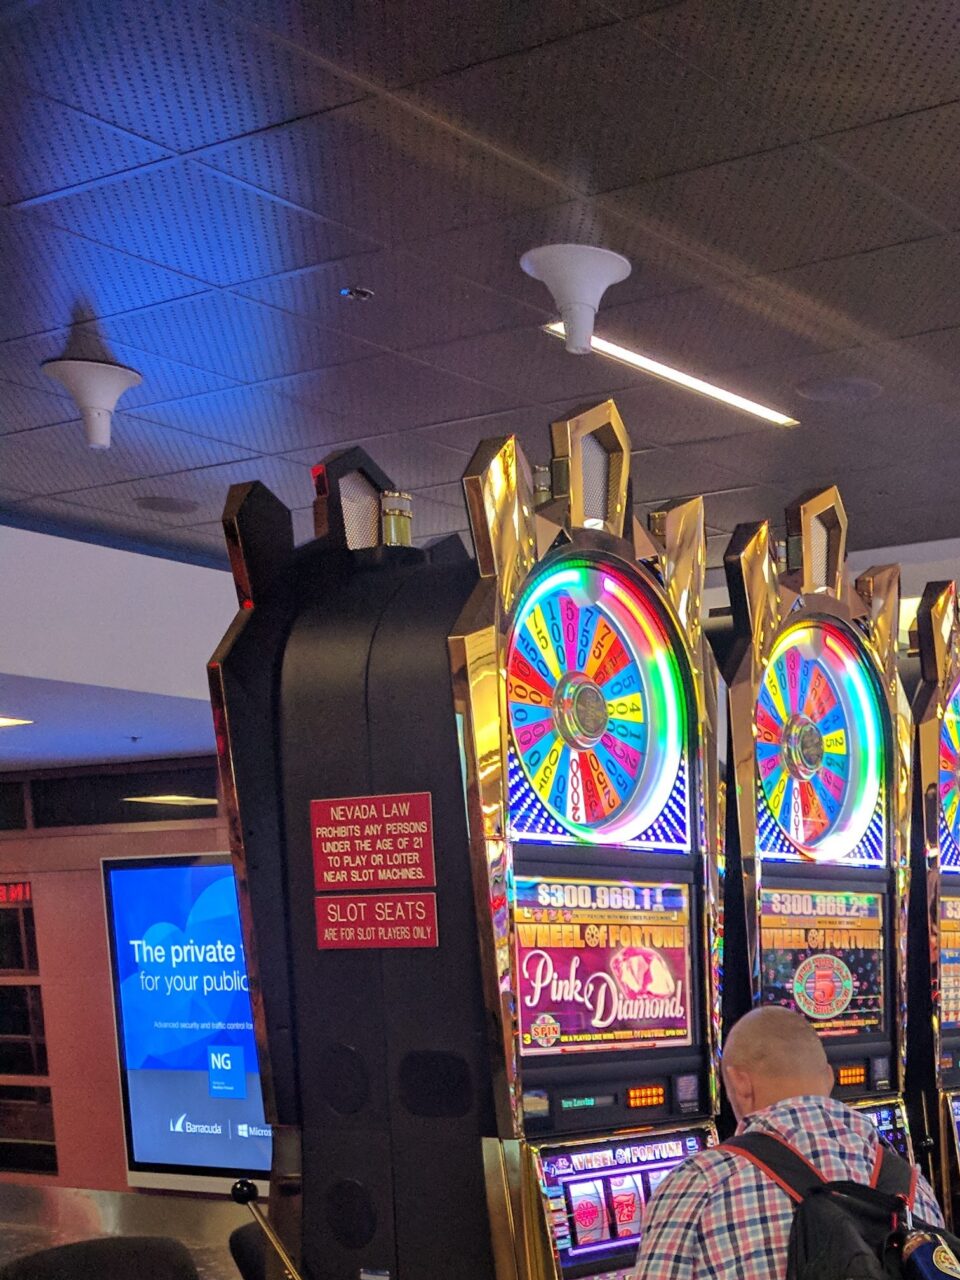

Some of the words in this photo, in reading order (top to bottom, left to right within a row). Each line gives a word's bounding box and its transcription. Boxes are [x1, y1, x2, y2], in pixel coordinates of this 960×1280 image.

[592, 624, 612, 660] 75
[570, 758, 580, 822] 2000
[330, 804, 378, 821] NEVADA
[382, 802, 410, 818] LAW
[316, 826, 361, 838] PROHIBITS
[364, 824, 382, 836] ANY
[385, 822, 428, 835] PERSONS
[321, 840, 351, 853] UNDER
[354, 840, 372, 852] THE
[375, 838, 394, 850] AGE
[397, 838, 409, 849] OF
[413, 837, 424, 849] 21
[327, 856, 341, 868] TO
[343, 854, 367, 867] PLAY
[370, 854, 385, 866] OR
[386, 852, 420, 865] LOITER
[323, 870, 348, 882] NEAR
[350, 869, 375, 881] SLOT
[378, 867, 426, 881] MACHINES.
[327, 903, 367, 922] SLOT
[375, 901, 426, 921] SEATS
[324, 928, 338, 941] ARE
[340, 927, 355, 941] FOR
[357, 927, 376, 940] SLOT
[378, 926, 411, 940] PLAYERS
[413, 926, 432, 940] ONLY
[517, 925, 585, 948] WHEEL
[608, 925, 685, 948] FORTUNE
[761, 929, 808, 949] WHEEL
[825, 929, 880, 949] FORTUNE
[129, 940, 166, 963] The
[170, 939, 236, 968] private
[140, 970, 160, 991] for
[164, 975, 198, 996] your
[203, 970, 249, 996] public
[522, 949, 586, 1007] Pink
[533, 1025, 558, 1037] SPIN
[211, 1053, 231, 1070] NG
[185, 1121, 222, 1134] Barracuda
[571, 1150, 617, 1171] WHEEL
[631, 1141, 683, 1162] FORTUNE
